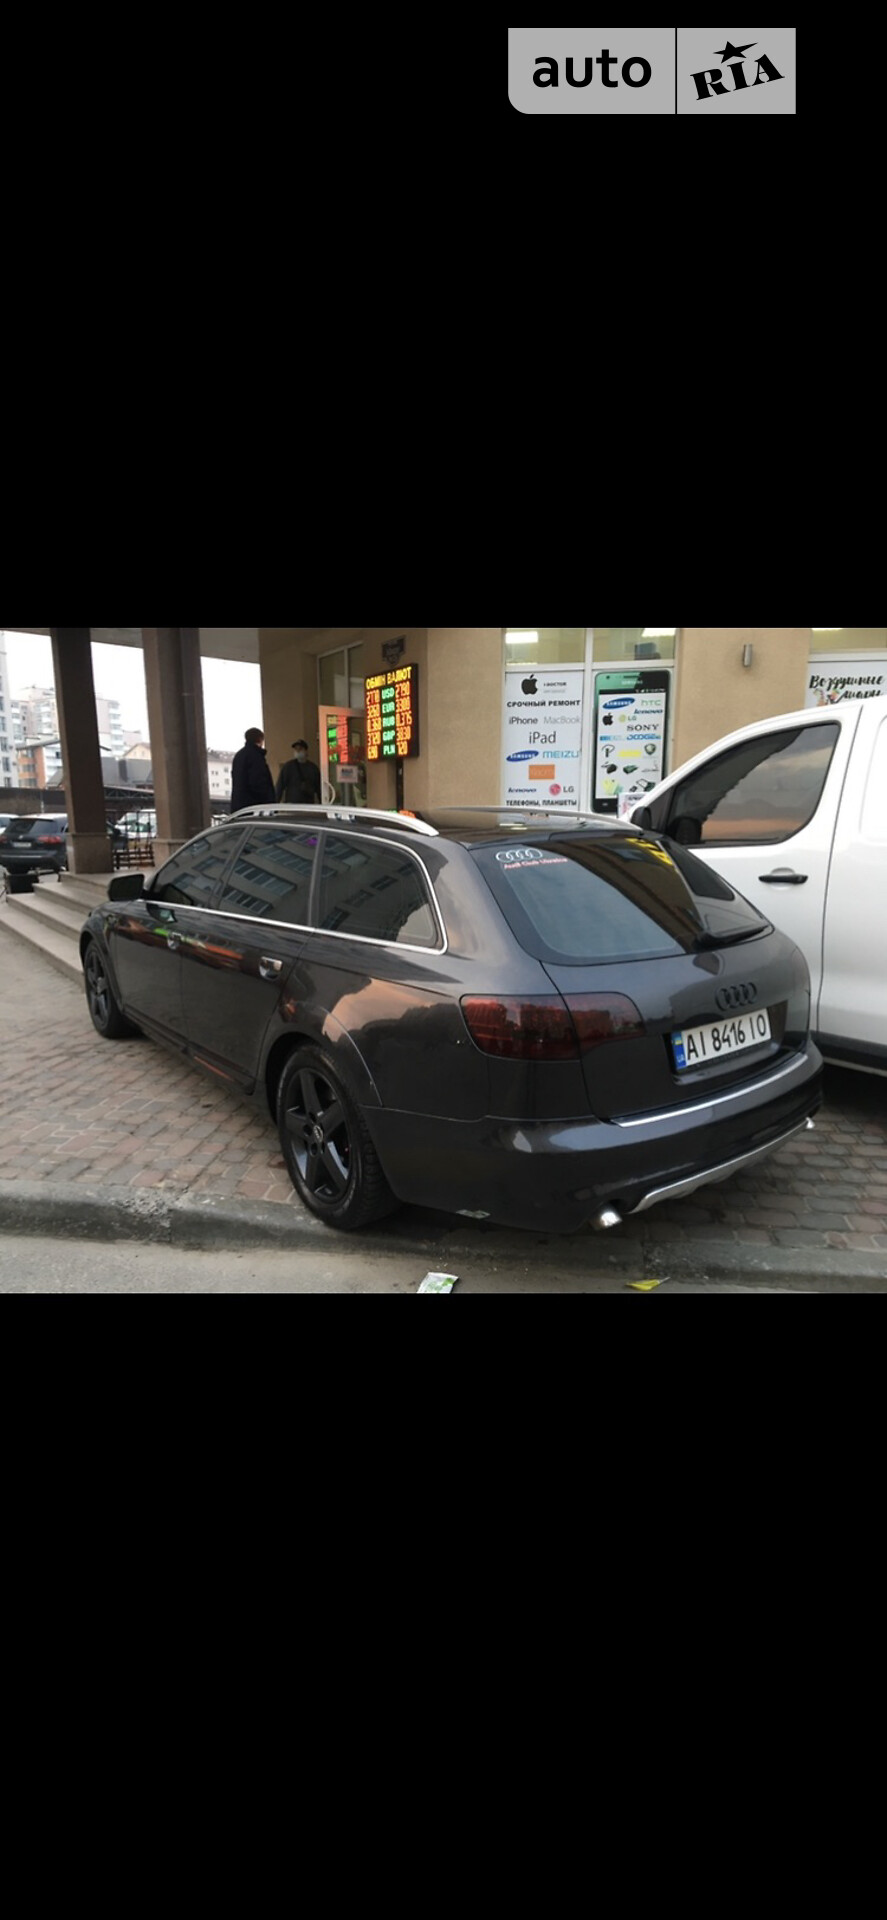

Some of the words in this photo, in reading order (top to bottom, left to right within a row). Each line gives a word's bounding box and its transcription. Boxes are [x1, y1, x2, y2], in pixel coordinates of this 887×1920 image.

[387, 666, 412, 684] ВАЛЮТ
[381, 687, 395, 699] USD
[382, 702, 395, 714] EUR
[382, 716, 395, 727] RUB
[543, 716, 580, 724] MacBook
[382, 731, 395, 741] GBP
[529, 731, 556, 744] iPad
[383, 744, 396, 755] PLN
[687, 1031, 706, 1061] AI
[711, 1020, 746, 1052] 8416
